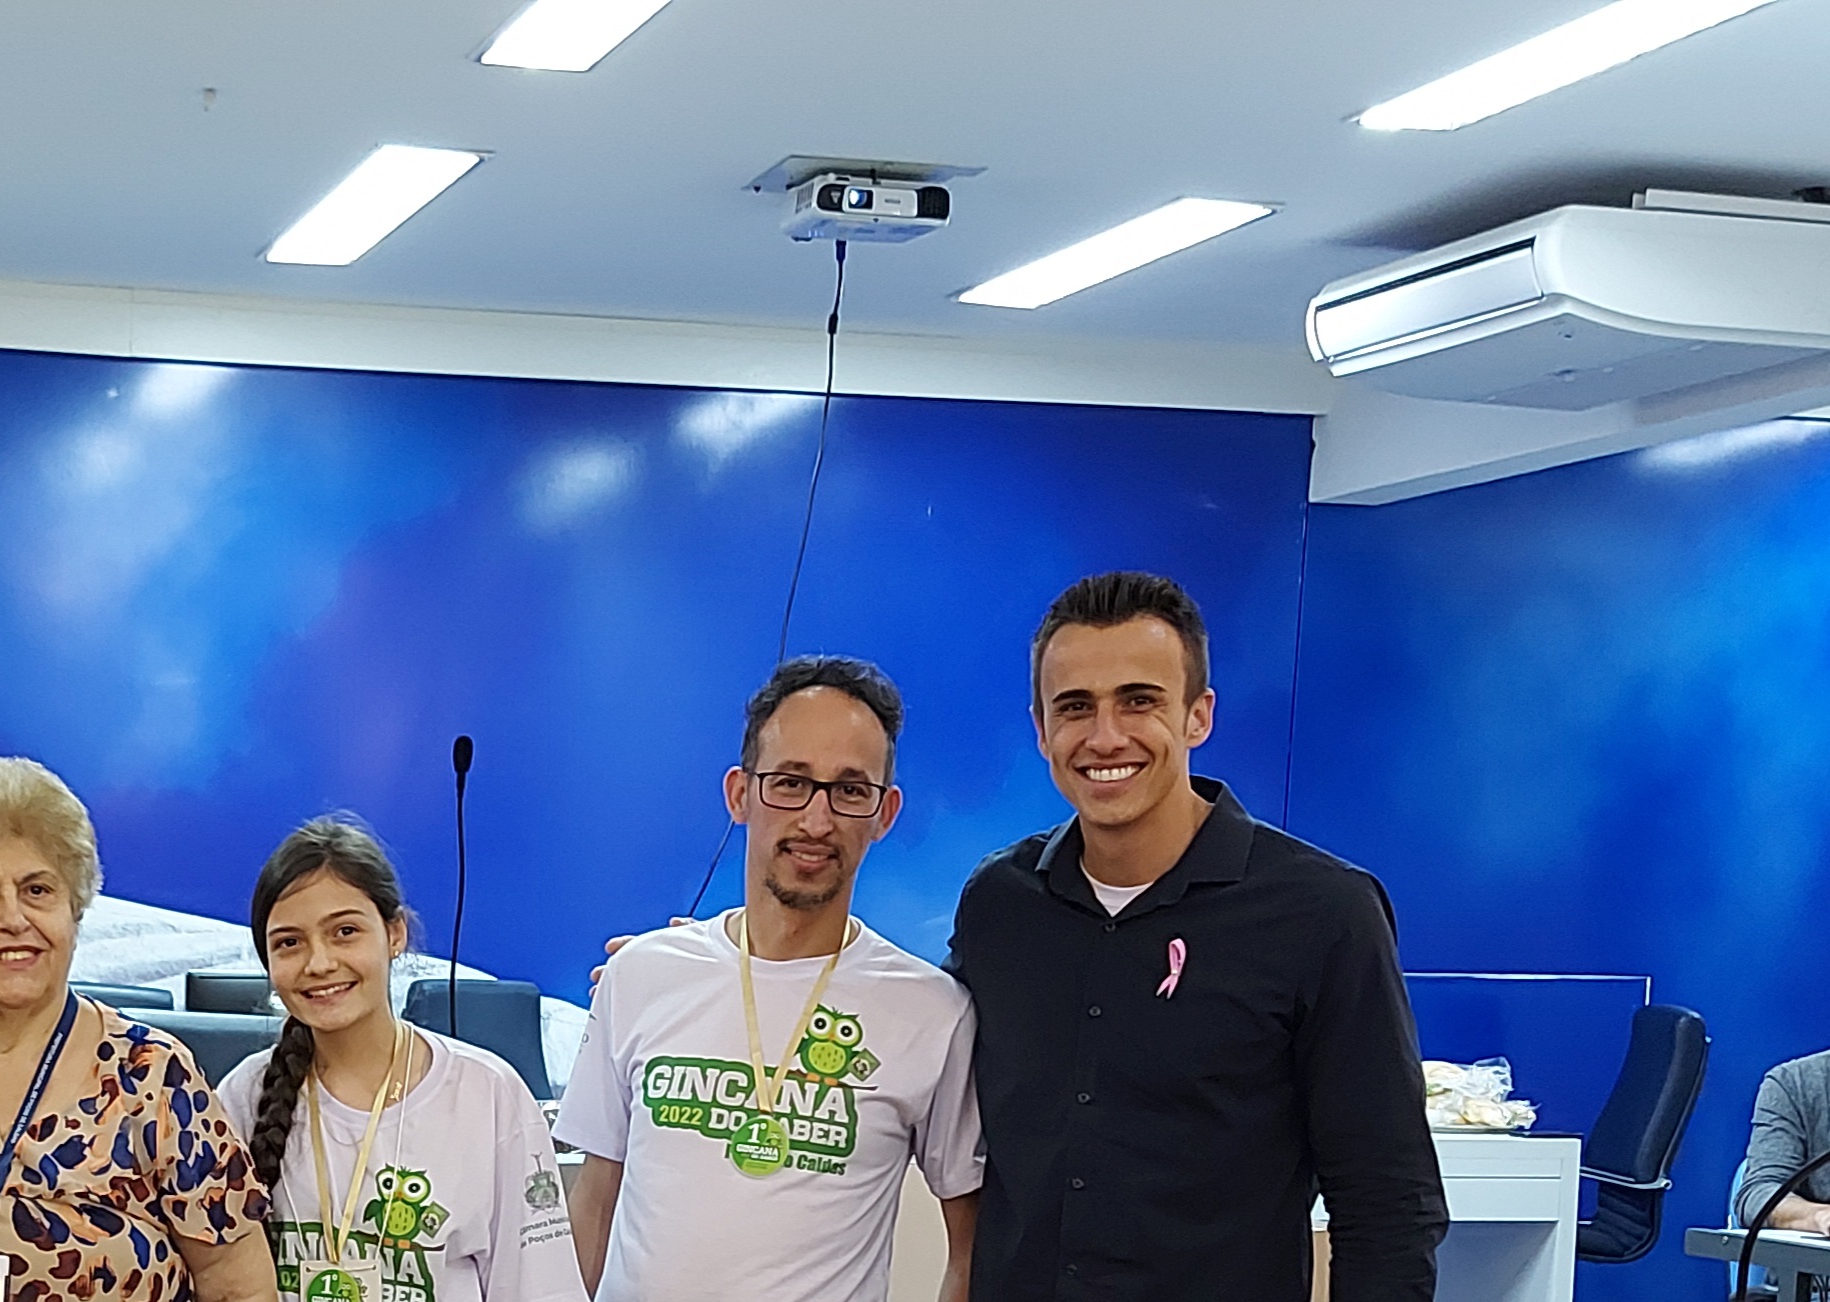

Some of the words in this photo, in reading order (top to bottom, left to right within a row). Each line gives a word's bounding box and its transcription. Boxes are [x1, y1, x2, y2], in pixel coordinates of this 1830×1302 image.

[659, 1105, 703, 1126] 2022
[708, 1108, 747, 1132] DO
[779, 1117, 847, 1149] ABER
